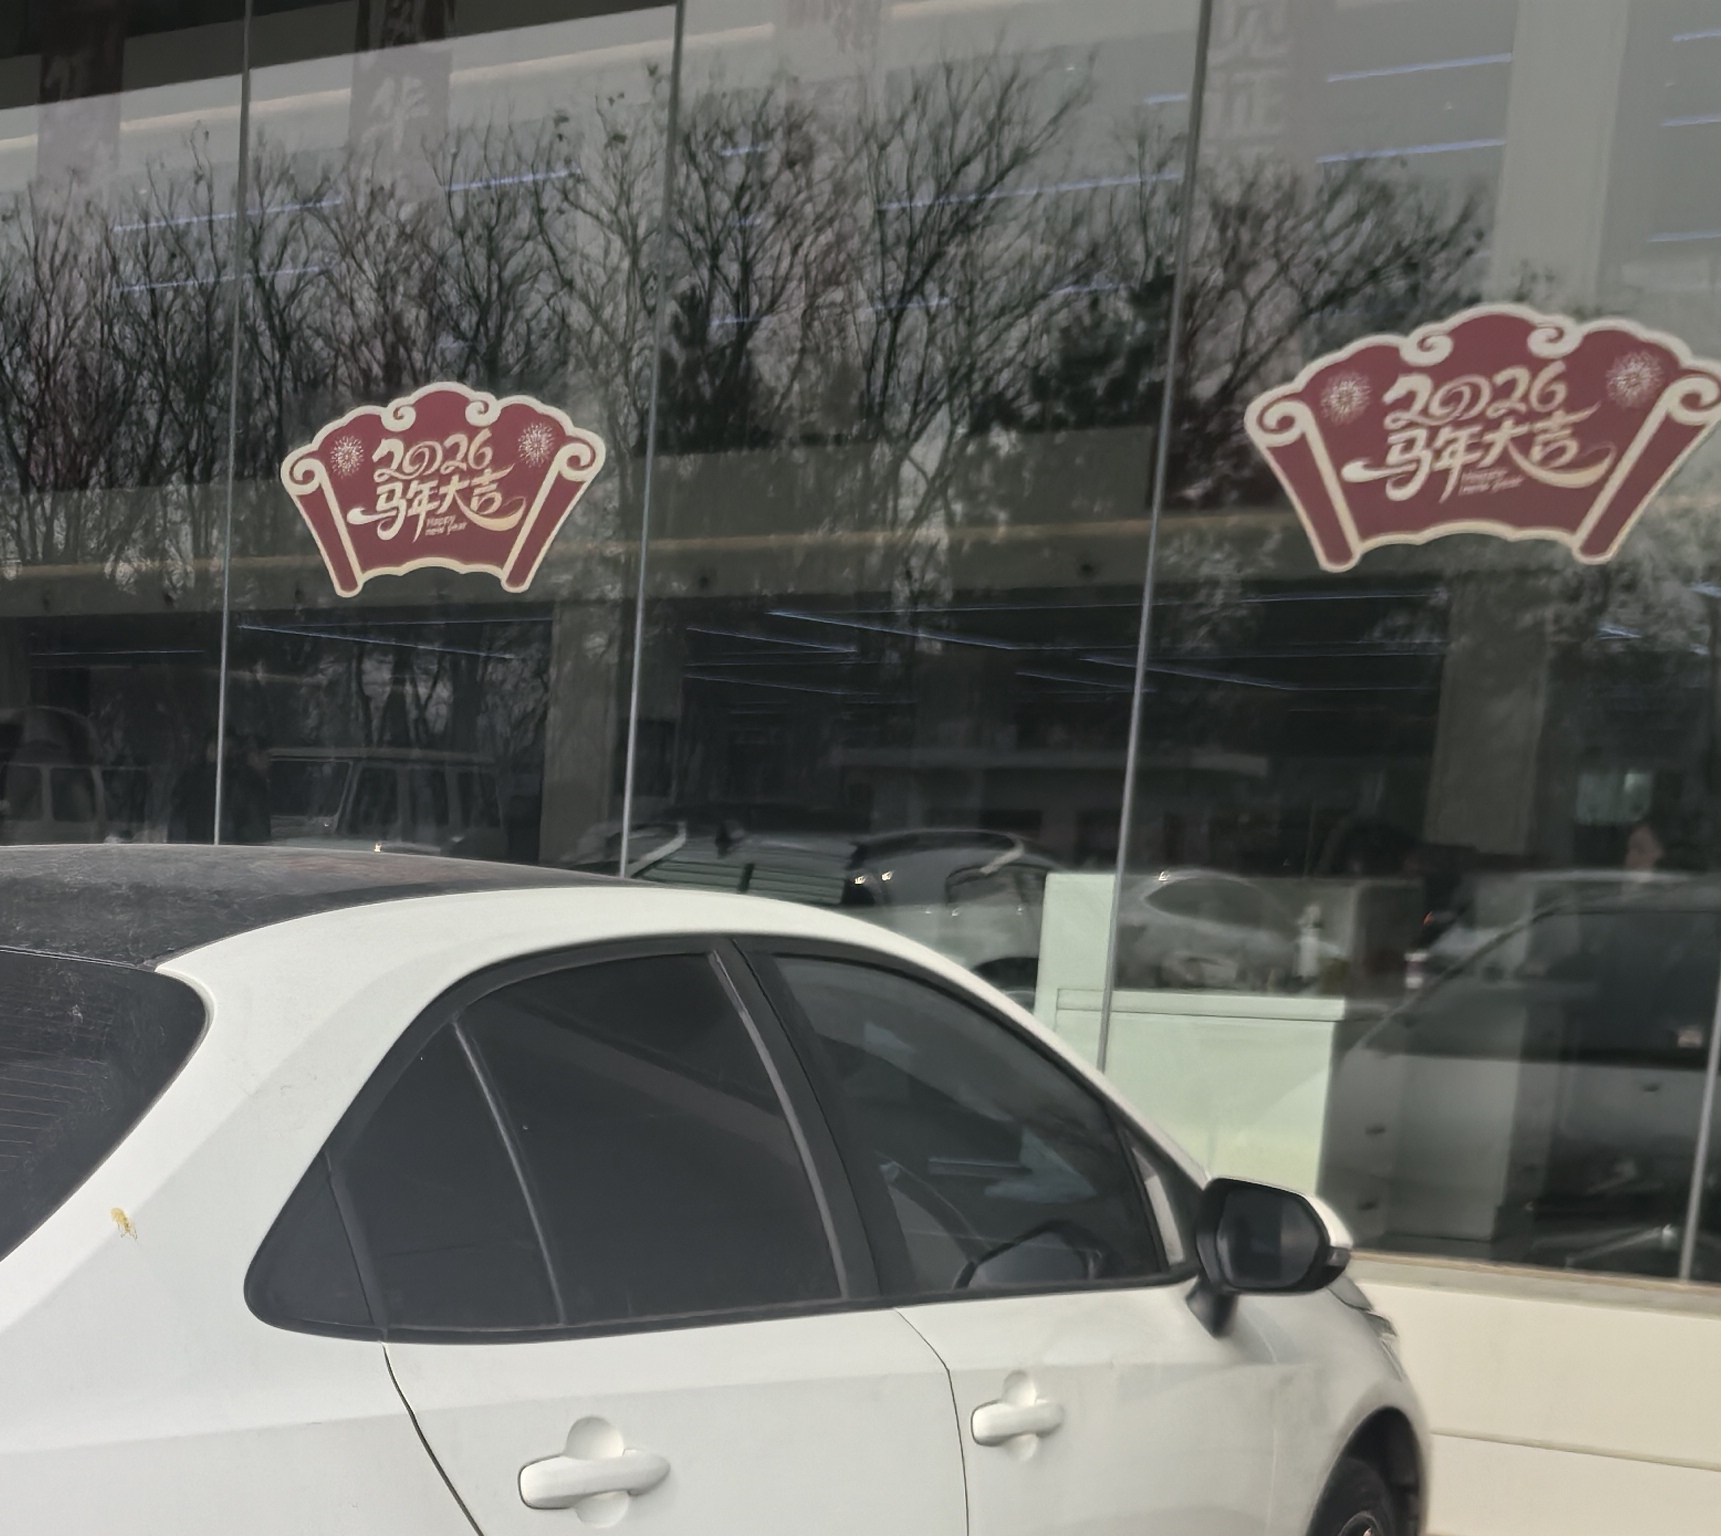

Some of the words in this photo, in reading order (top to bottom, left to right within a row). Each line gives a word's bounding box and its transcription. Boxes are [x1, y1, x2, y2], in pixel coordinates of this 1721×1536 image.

[1382, 360, 1568, 430] 2026
[372, 428, 493, 482] 2026
[1341, 401, 1617, 503] 马年大吉
[347, 463, 526, 543] 马年大吉
